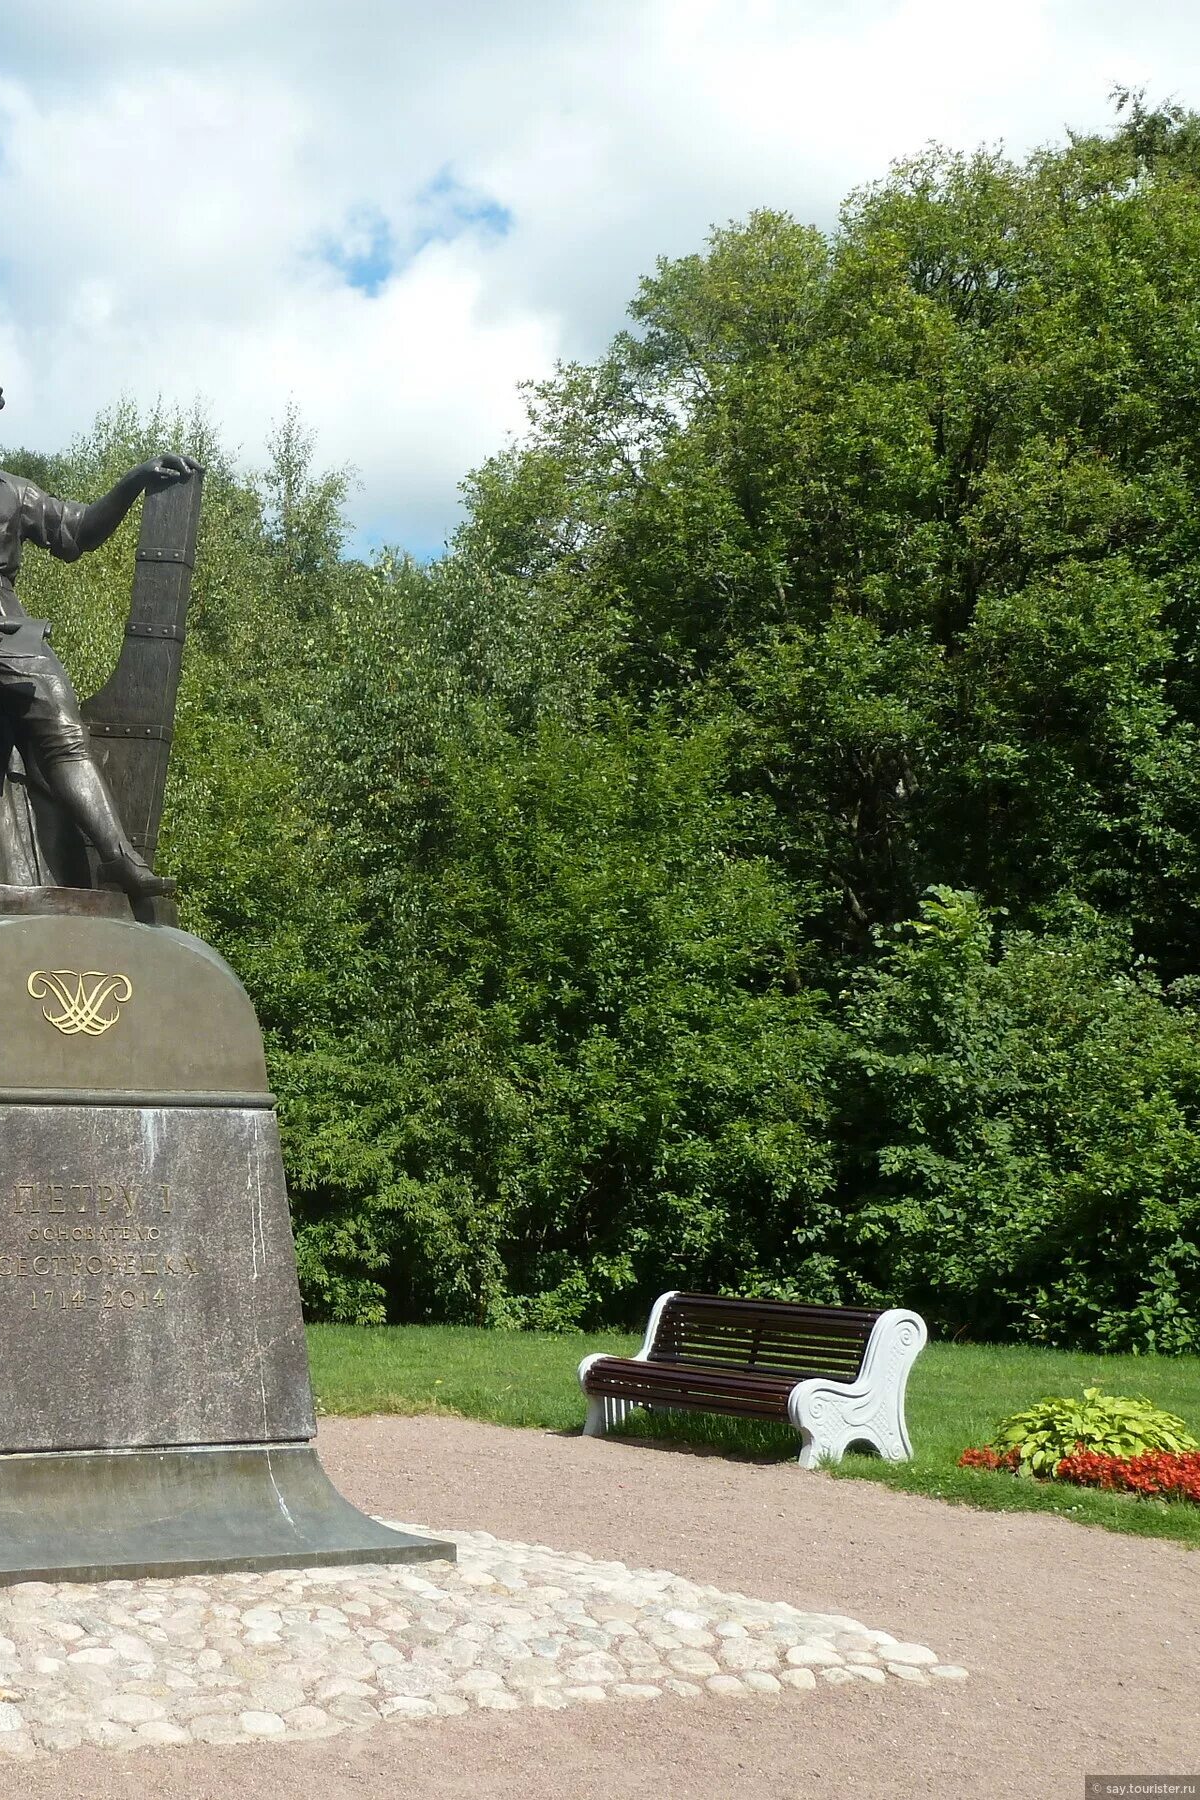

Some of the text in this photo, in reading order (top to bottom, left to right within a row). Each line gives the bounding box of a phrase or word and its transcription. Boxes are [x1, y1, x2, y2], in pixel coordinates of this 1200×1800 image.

[13, 1184, 174, 1218] ПЕТРУ I
[28, 1227, 161, 1242] ОСНОВАТЕЛЮ
